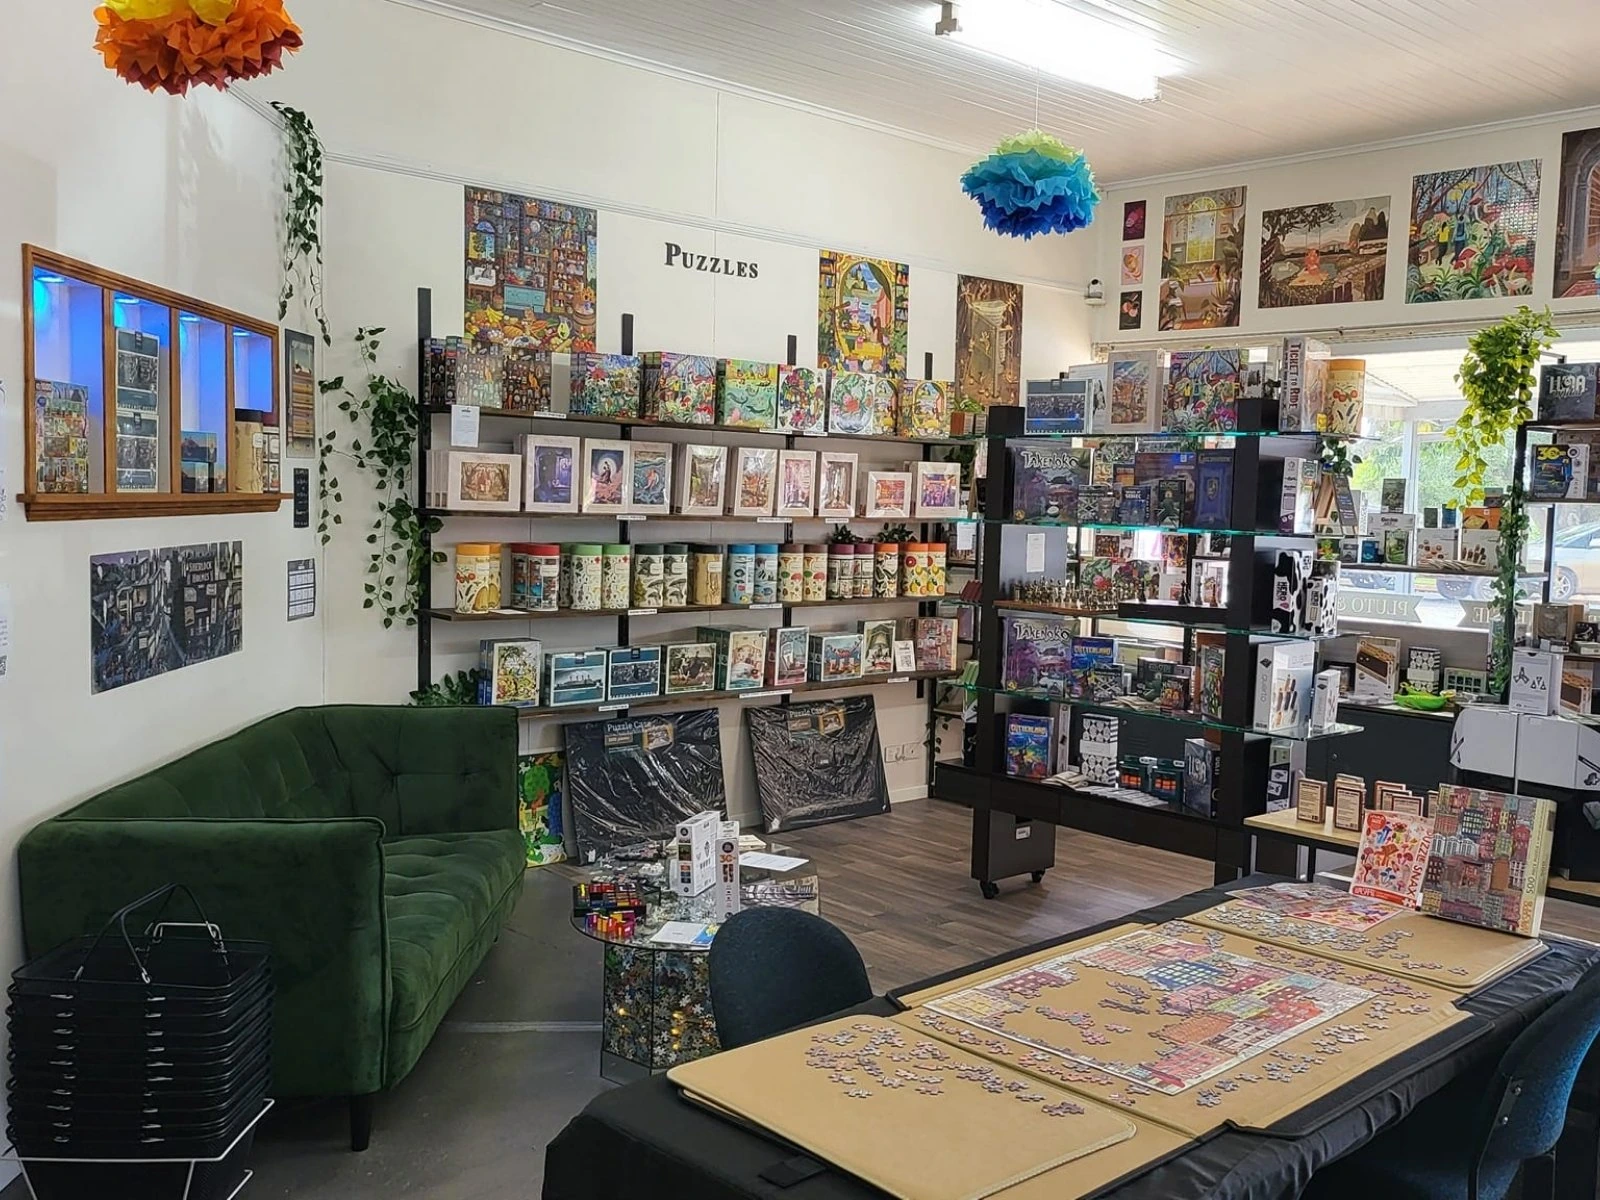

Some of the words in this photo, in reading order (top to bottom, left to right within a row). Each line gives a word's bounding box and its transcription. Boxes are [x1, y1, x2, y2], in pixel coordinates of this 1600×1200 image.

[1289, 344, 1301, 377] TICKET
[1289, 387, 1301, 409] RIDE
[1013, 622, 1071, 641] TAKENOKO
[607, 721, 633, 732] Puzzle
[1415, 829, 1434, 863] PUZZLE
[1407, 865, 1422, 896] SNAX
[1526, 876, 1536, 894] 500
